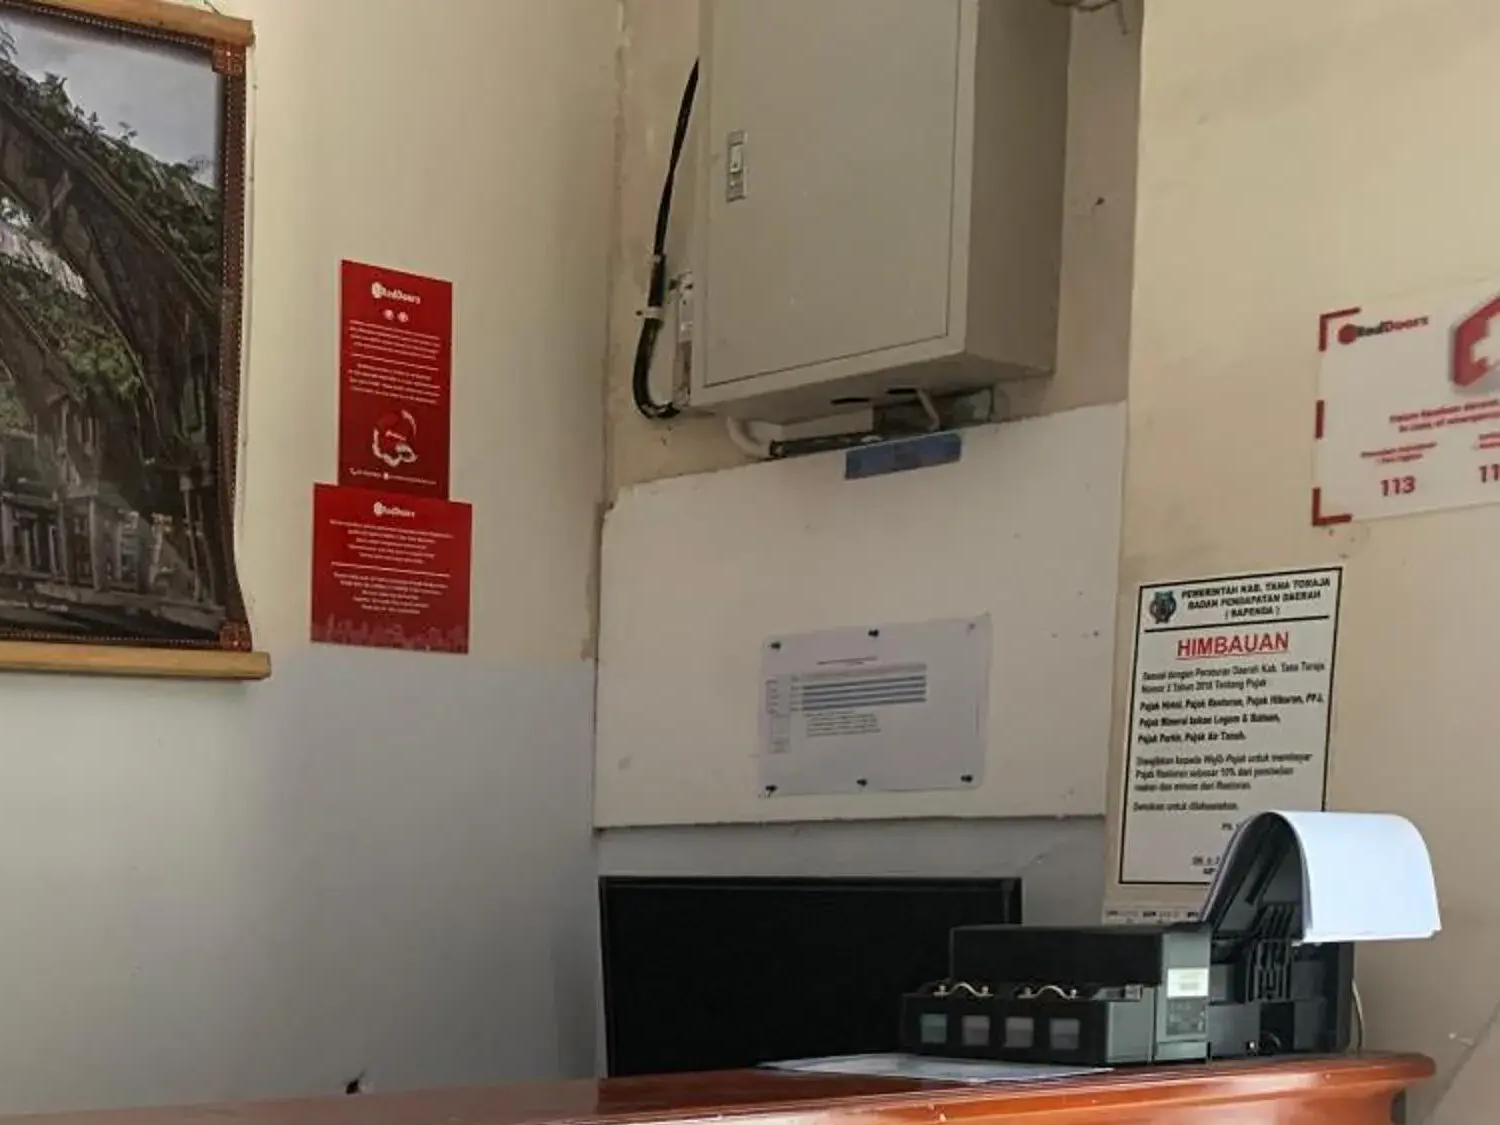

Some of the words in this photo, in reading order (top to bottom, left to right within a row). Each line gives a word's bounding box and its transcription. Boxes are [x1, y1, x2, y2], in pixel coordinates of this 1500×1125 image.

[1380, 475, 1416, 496] 113
[1181, 587, 1239, 599] PEMERINTAH
[1265, 582, 1290, 592] TANA
[1292, 578, 1331, 588] TORAJA
[1188, 600, 1220, 610] BADAN
[1221, 594, 1280, 608] PENDAPATAN
[1282, 591, 1321, 601] DAERAH
[1231, 606, 1273, 618] BAPENDA
[1177, 632, 1289, 656] HIMBAUAN
[1246, 678, 1267, 688] Pajak
[1140, 702, 1160, 711] Pajak
[1185, 699, 1206, 709] Pajak
[1246, 696, 1268, 706] Pajak
[1139, 718, 1159, 728] Pajak
[1214, 715, 1240, 725] Logam
[1138, 735, 1157, 745] Pajak
[1185, 732, 1206, 742] Pajak
